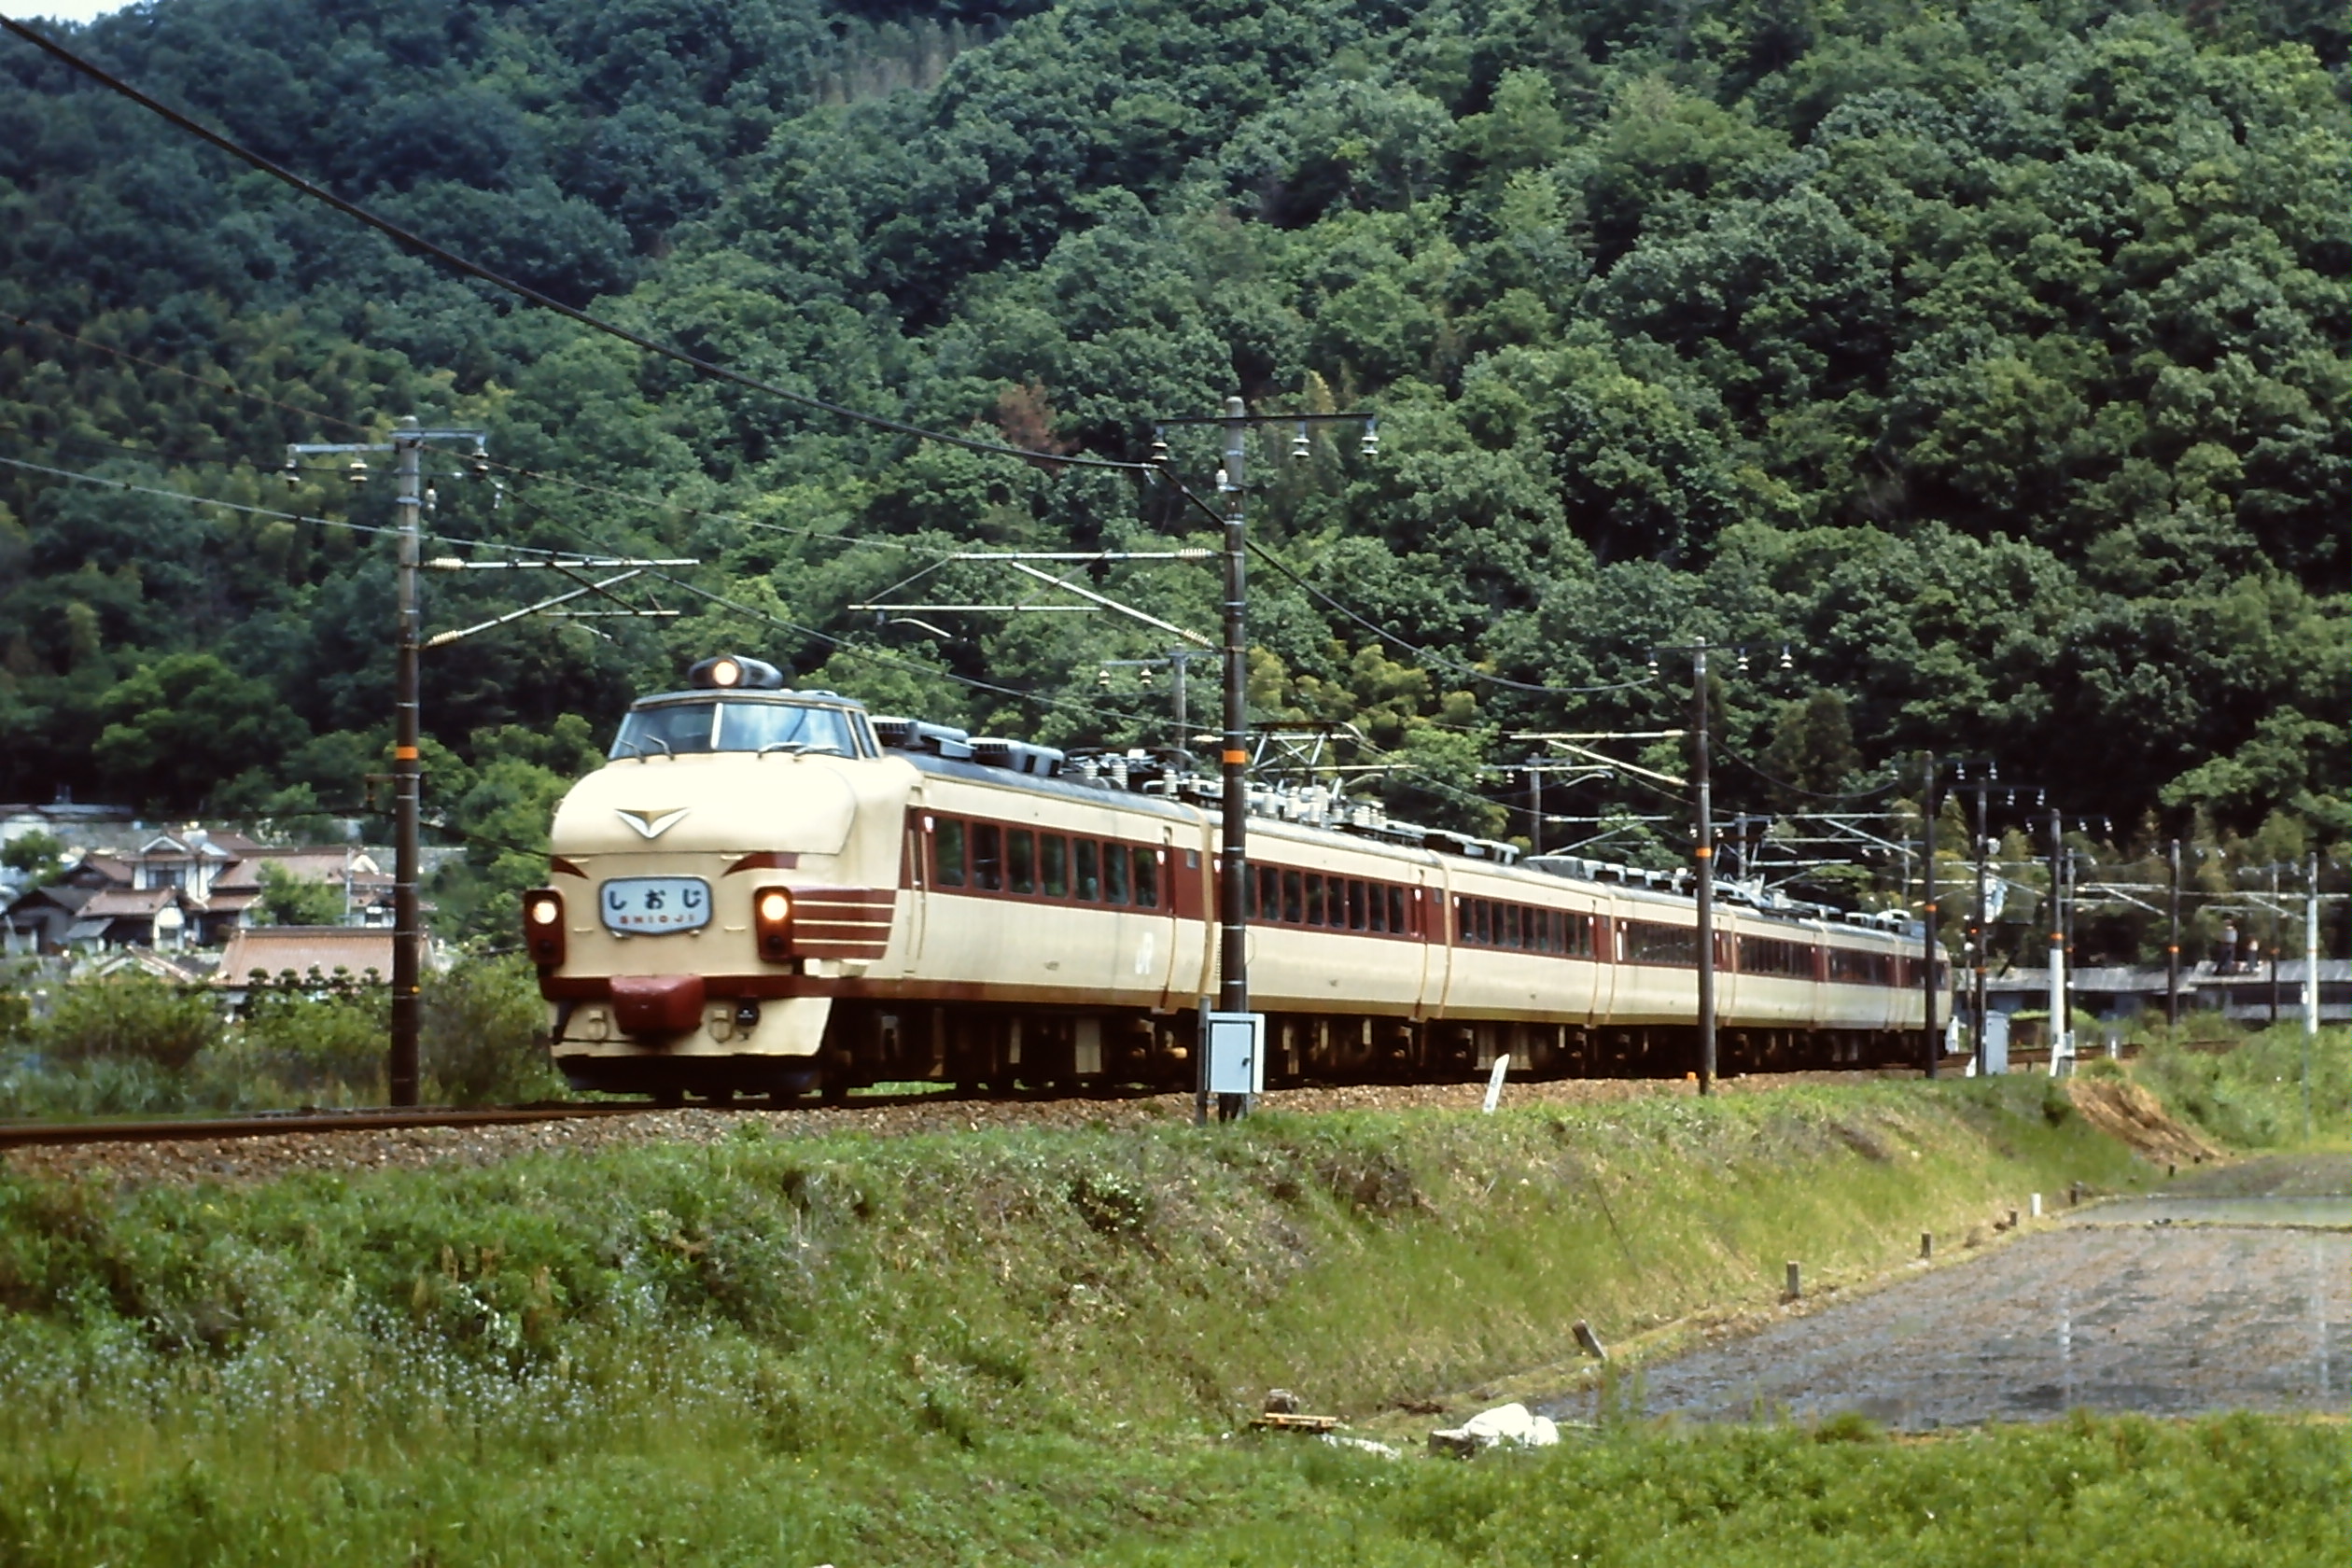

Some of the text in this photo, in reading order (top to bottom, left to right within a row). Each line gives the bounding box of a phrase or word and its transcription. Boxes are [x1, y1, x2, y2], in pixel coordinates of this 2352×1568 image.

[609, 889, 702, 910] しおじ
[619, 914, 694, 924] SHIOJI
